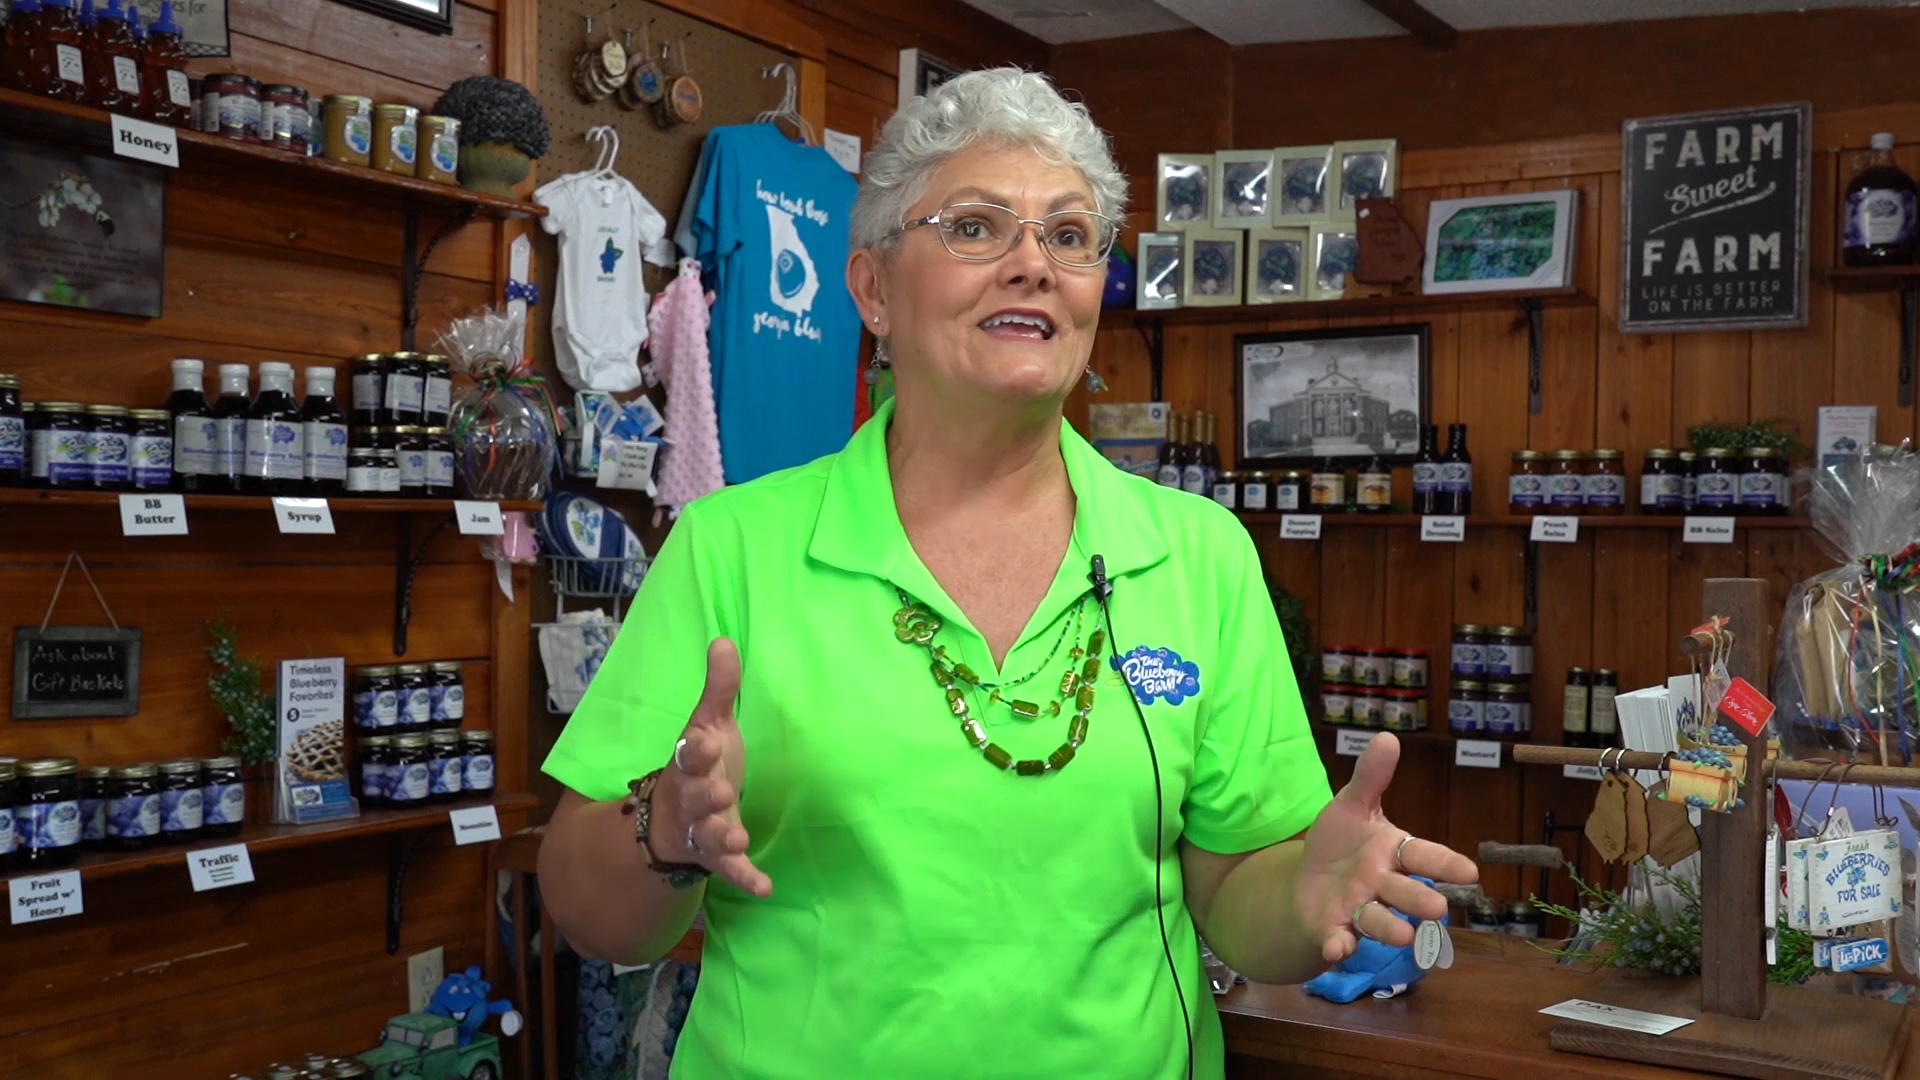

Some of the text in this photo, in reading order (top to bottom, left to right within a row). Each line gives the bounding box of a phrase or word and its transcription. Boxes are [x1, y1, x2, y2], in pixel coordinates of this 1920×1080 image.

[120, 129, 172, 154] Honey
[1645, 121, 1783, 170] FARM
[1664, 164, 1757, 214] Sweet
[1642, 232, 1781, 276] FARM
[1642, 280, 1781, 299] LIFE IS BETTER
[1649, 296, 1773, 313] ON THE FARM
[145, 499, 162, 510] BB
[135, 514, 175, 525] Butter
[288, 511, 322, 523] Syrup
[471, 513, 490, 523] Jam
[32, 645, 116, 662] Ask about
[290, 664, 333, 675] Timeless
[1122, 657, 1187, 686] Blueberry
[32, 672, 124, 692] Gift Baskets
[290, 678, 338, 689] Blueberry
[290, 690, 335, 702] Favorites
[1844, 840, 1870, 856] Fresh
[199, 854, 239, 868] Traffic
[31, 879, 61, 890] Fruit
[18, 892, 58, 906] Spread
[1837, 884, 1881, 903] FOR SALE
[30, 906, 65, 918] Honey
